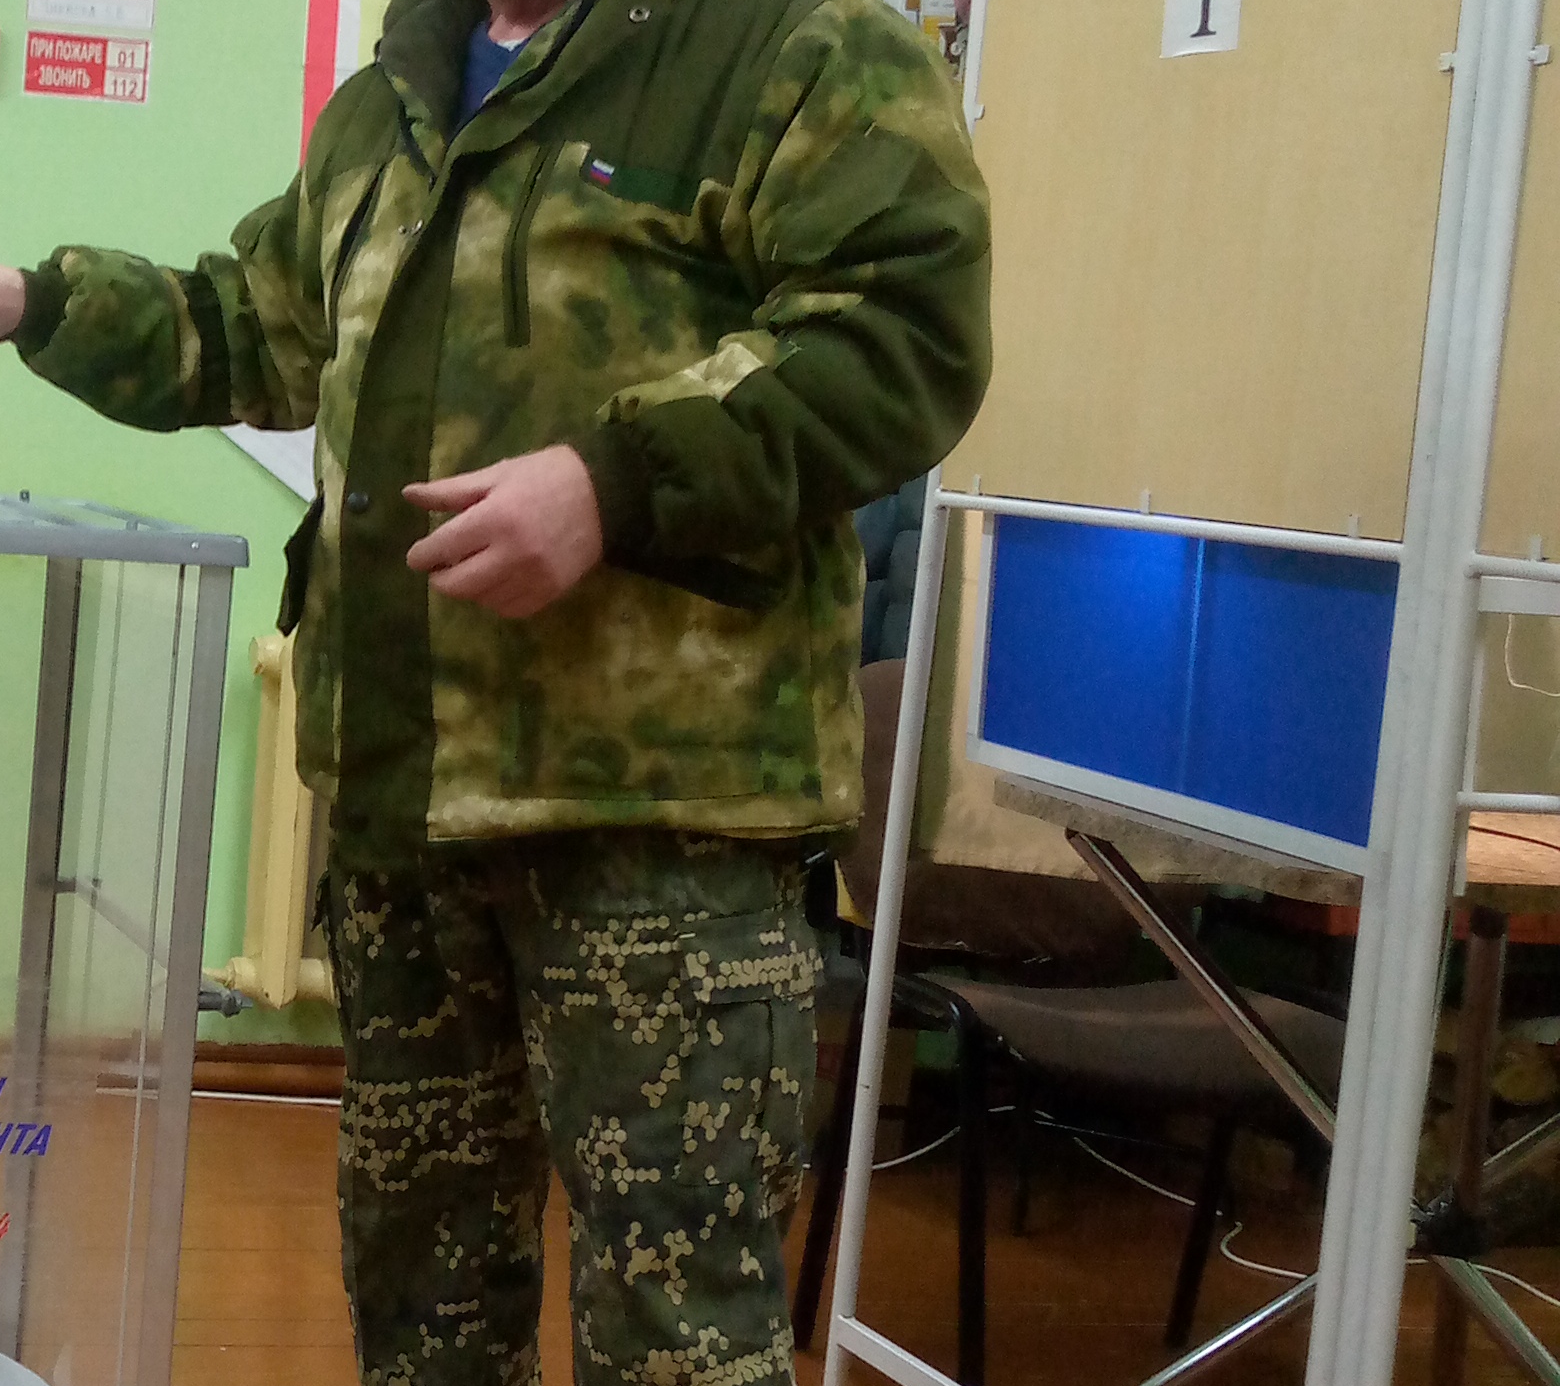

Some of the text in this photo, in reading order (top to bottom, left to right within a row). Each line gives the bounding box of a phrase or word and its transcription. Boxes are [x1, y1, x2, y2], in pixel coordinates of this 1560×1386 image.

[30, 37, 103, 64] ПРИ ПОЖАРЕ
[118, 51, 135, 68] 01
[39, 64, 91, 89] ЗВОНИТЬ
[112, 79, 138, 97] 112
